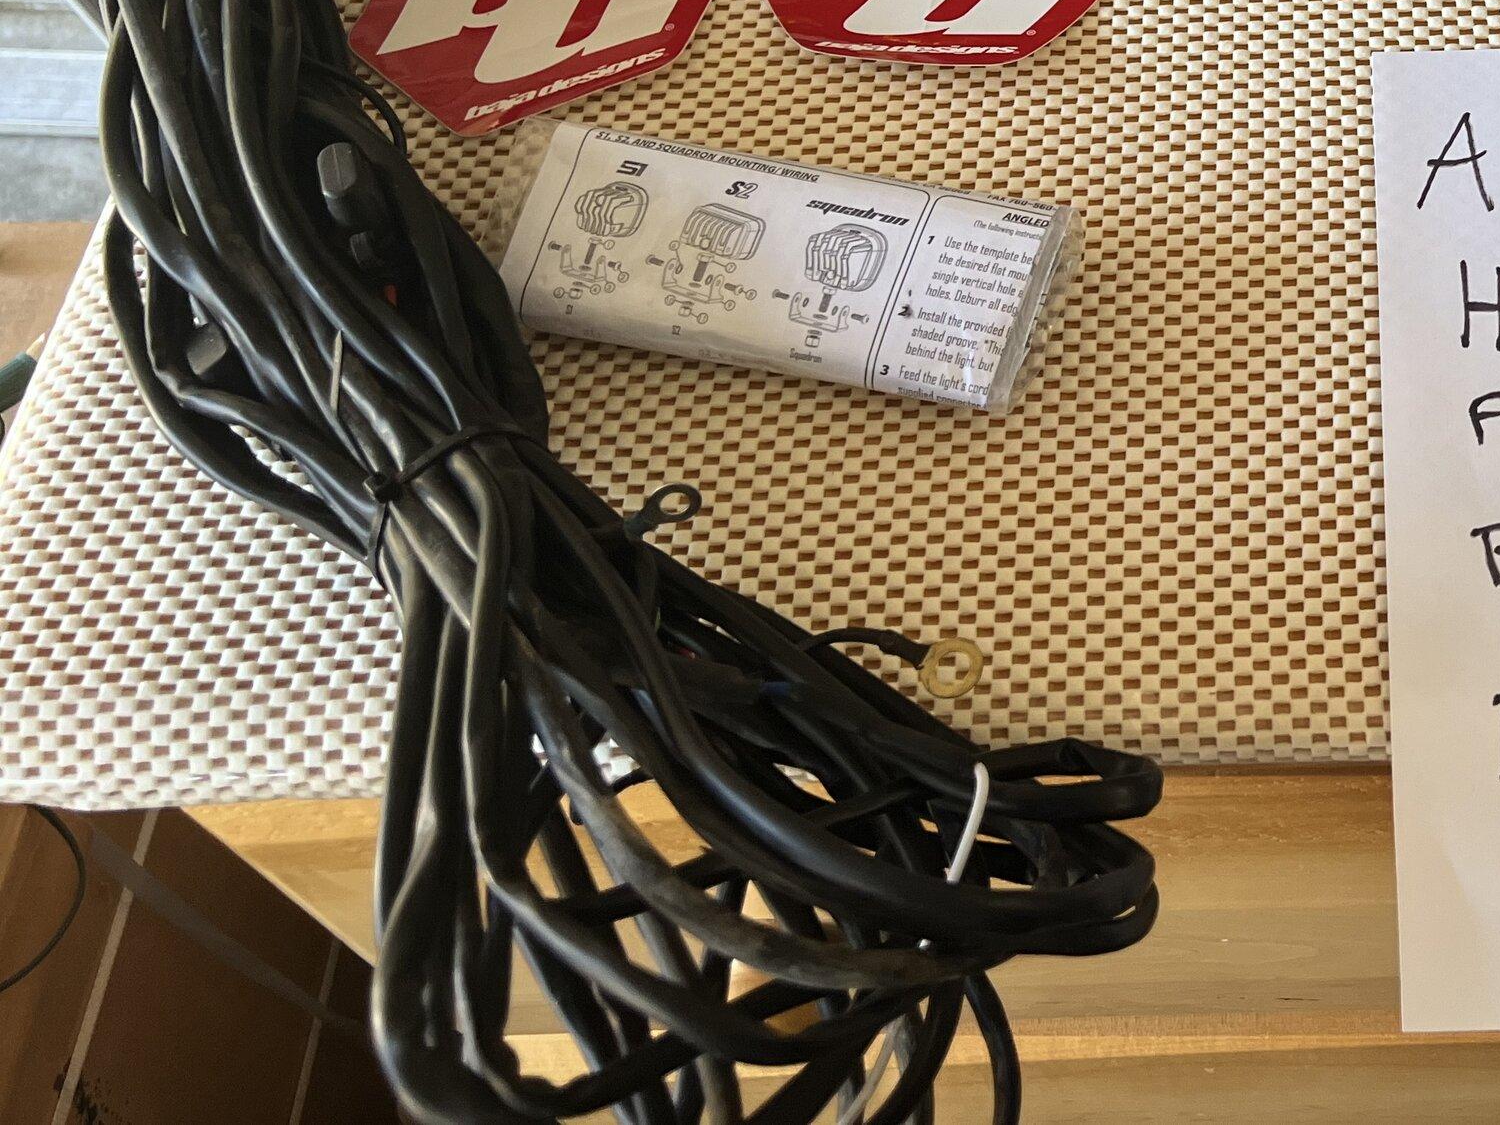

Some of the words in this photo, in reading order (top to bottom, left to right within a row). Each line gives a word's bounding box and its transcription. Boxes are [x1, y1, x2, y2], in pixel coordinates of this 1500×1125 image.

[464, 90, 538, 122] baja
[537, 47, 667, 98] designs
[632, 138, 657, 149] AND
[657, 143, 717, 161] SQUADRON
[616, 160, 649, 177] S1
[725, 180, 759, 200] S2
[806, 199, 910, 226] squadron
[1001, 211, 1050, 228] ANGLED
[926, 235, 936, 246] 1
[944, 235, 962, 251] Use
[963, 239, 978, 255] the
[979, 242, 1020, 264] template
[1020, 251, 1034, 265] be
[938, 251, 954, 266] the
[955, 254, 990, 273] desired
[990, 261, 1007, 277] flat
[931, 269, 959, 286] single
[960, 272, 997, 292] vertical
[996, 282, 1016, 297] hole
[925, 283, 952, 300] holes.
[954, 289, 988, 307] Deburr
[988, 298, 1000, 311] all
[897, 305, 911, 317] 2
[917, 306, 947, 324] Install
[948, 314, 962, 328] the
[963, 320, 1006, 338] provided
[911, 325, 945, 343] shaded
[905, 341, 937, 360] behind
[937, 349, 952, 364] the
[977, 358, 995, 373] but
[879, 364, 890, 376] 3
[898, 364, 921, 382] Feed
[922, 369, 937, 385] the
[938, 373, 968, 393] light's
[967, 380, 991, 396] cord
